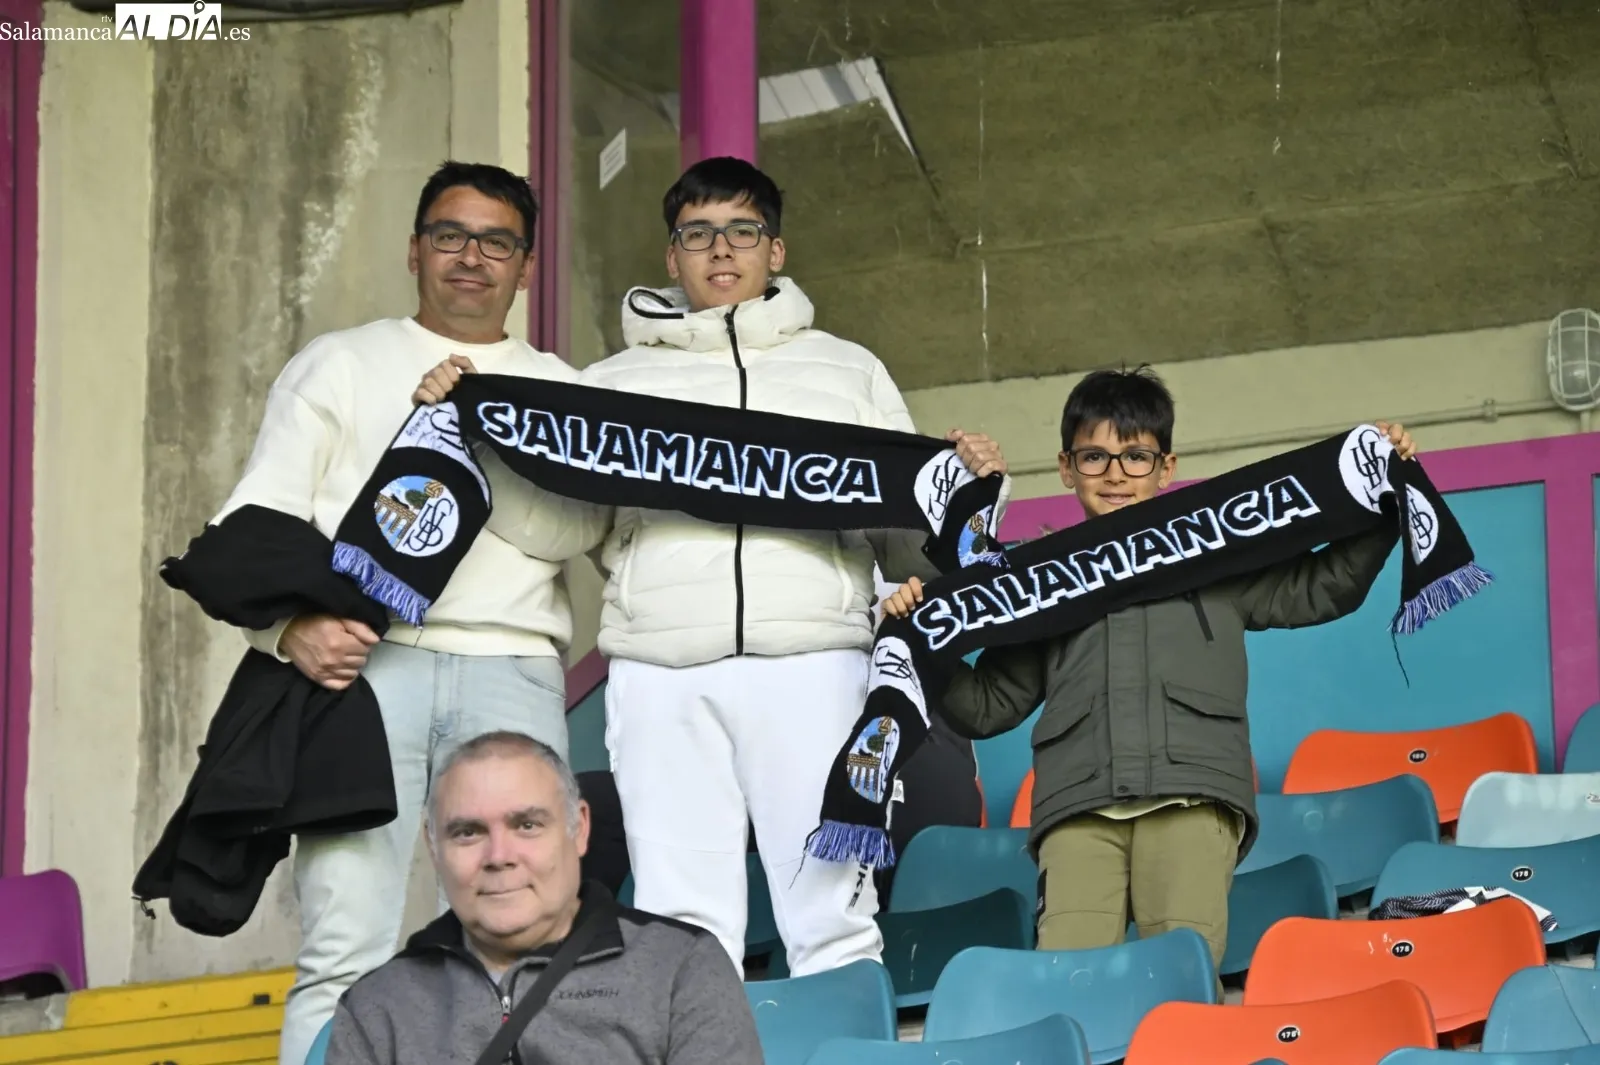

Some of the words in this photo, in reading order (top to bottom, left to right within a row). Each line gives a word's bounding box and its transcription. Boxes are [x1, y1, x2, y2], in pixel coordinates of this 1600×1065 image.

[477, 401, 882, 503] SALAMANCA
[912, 475, 1322, 651] SALAMANCA
[848, 862, 869, 908] IKE
